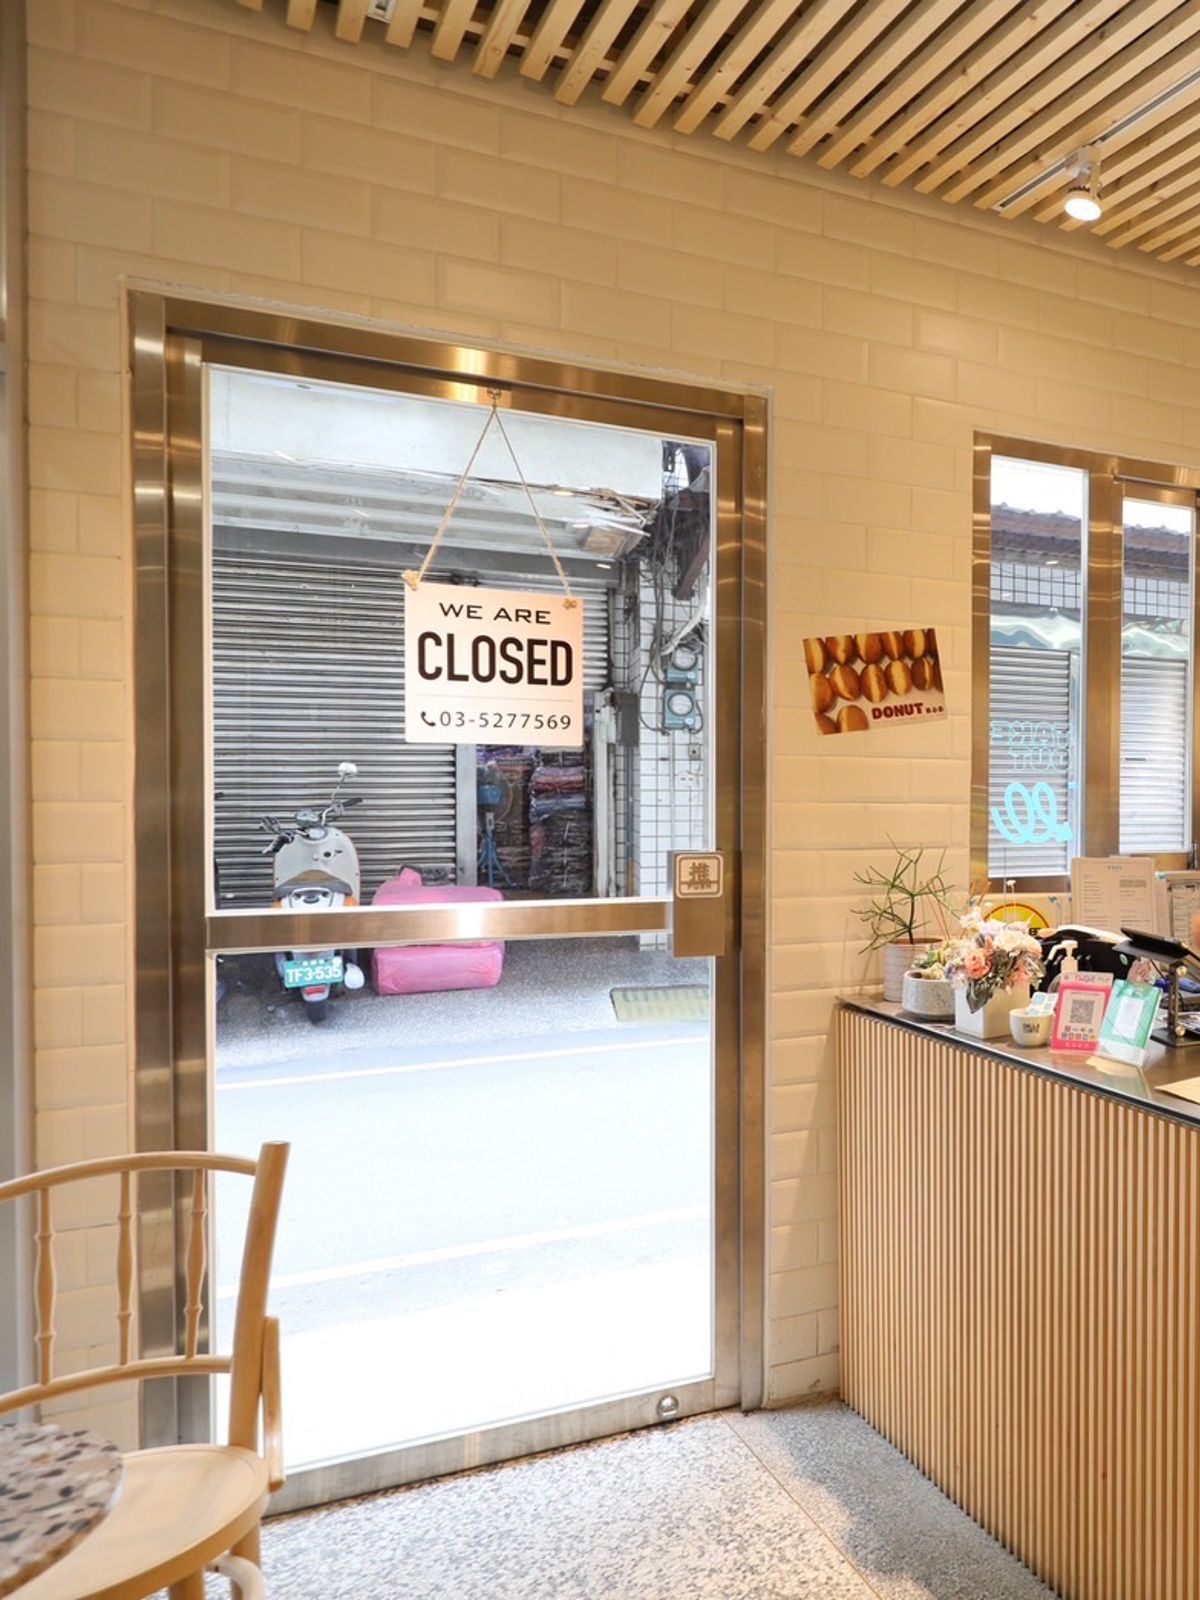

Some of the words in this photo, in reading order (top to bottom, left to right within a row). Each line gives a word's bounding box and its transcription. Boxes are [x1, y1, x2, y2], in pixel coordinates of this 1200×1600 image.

[439, 602, 483, 620] WE
[493, 607, 552, 625] ARE
[417, 631, 574, 687] CLOSED
[440, 710, 572, 730] 03-5277569
[871, 702, 924, 720] DONUT
[689, 861, 711, 885] 推
